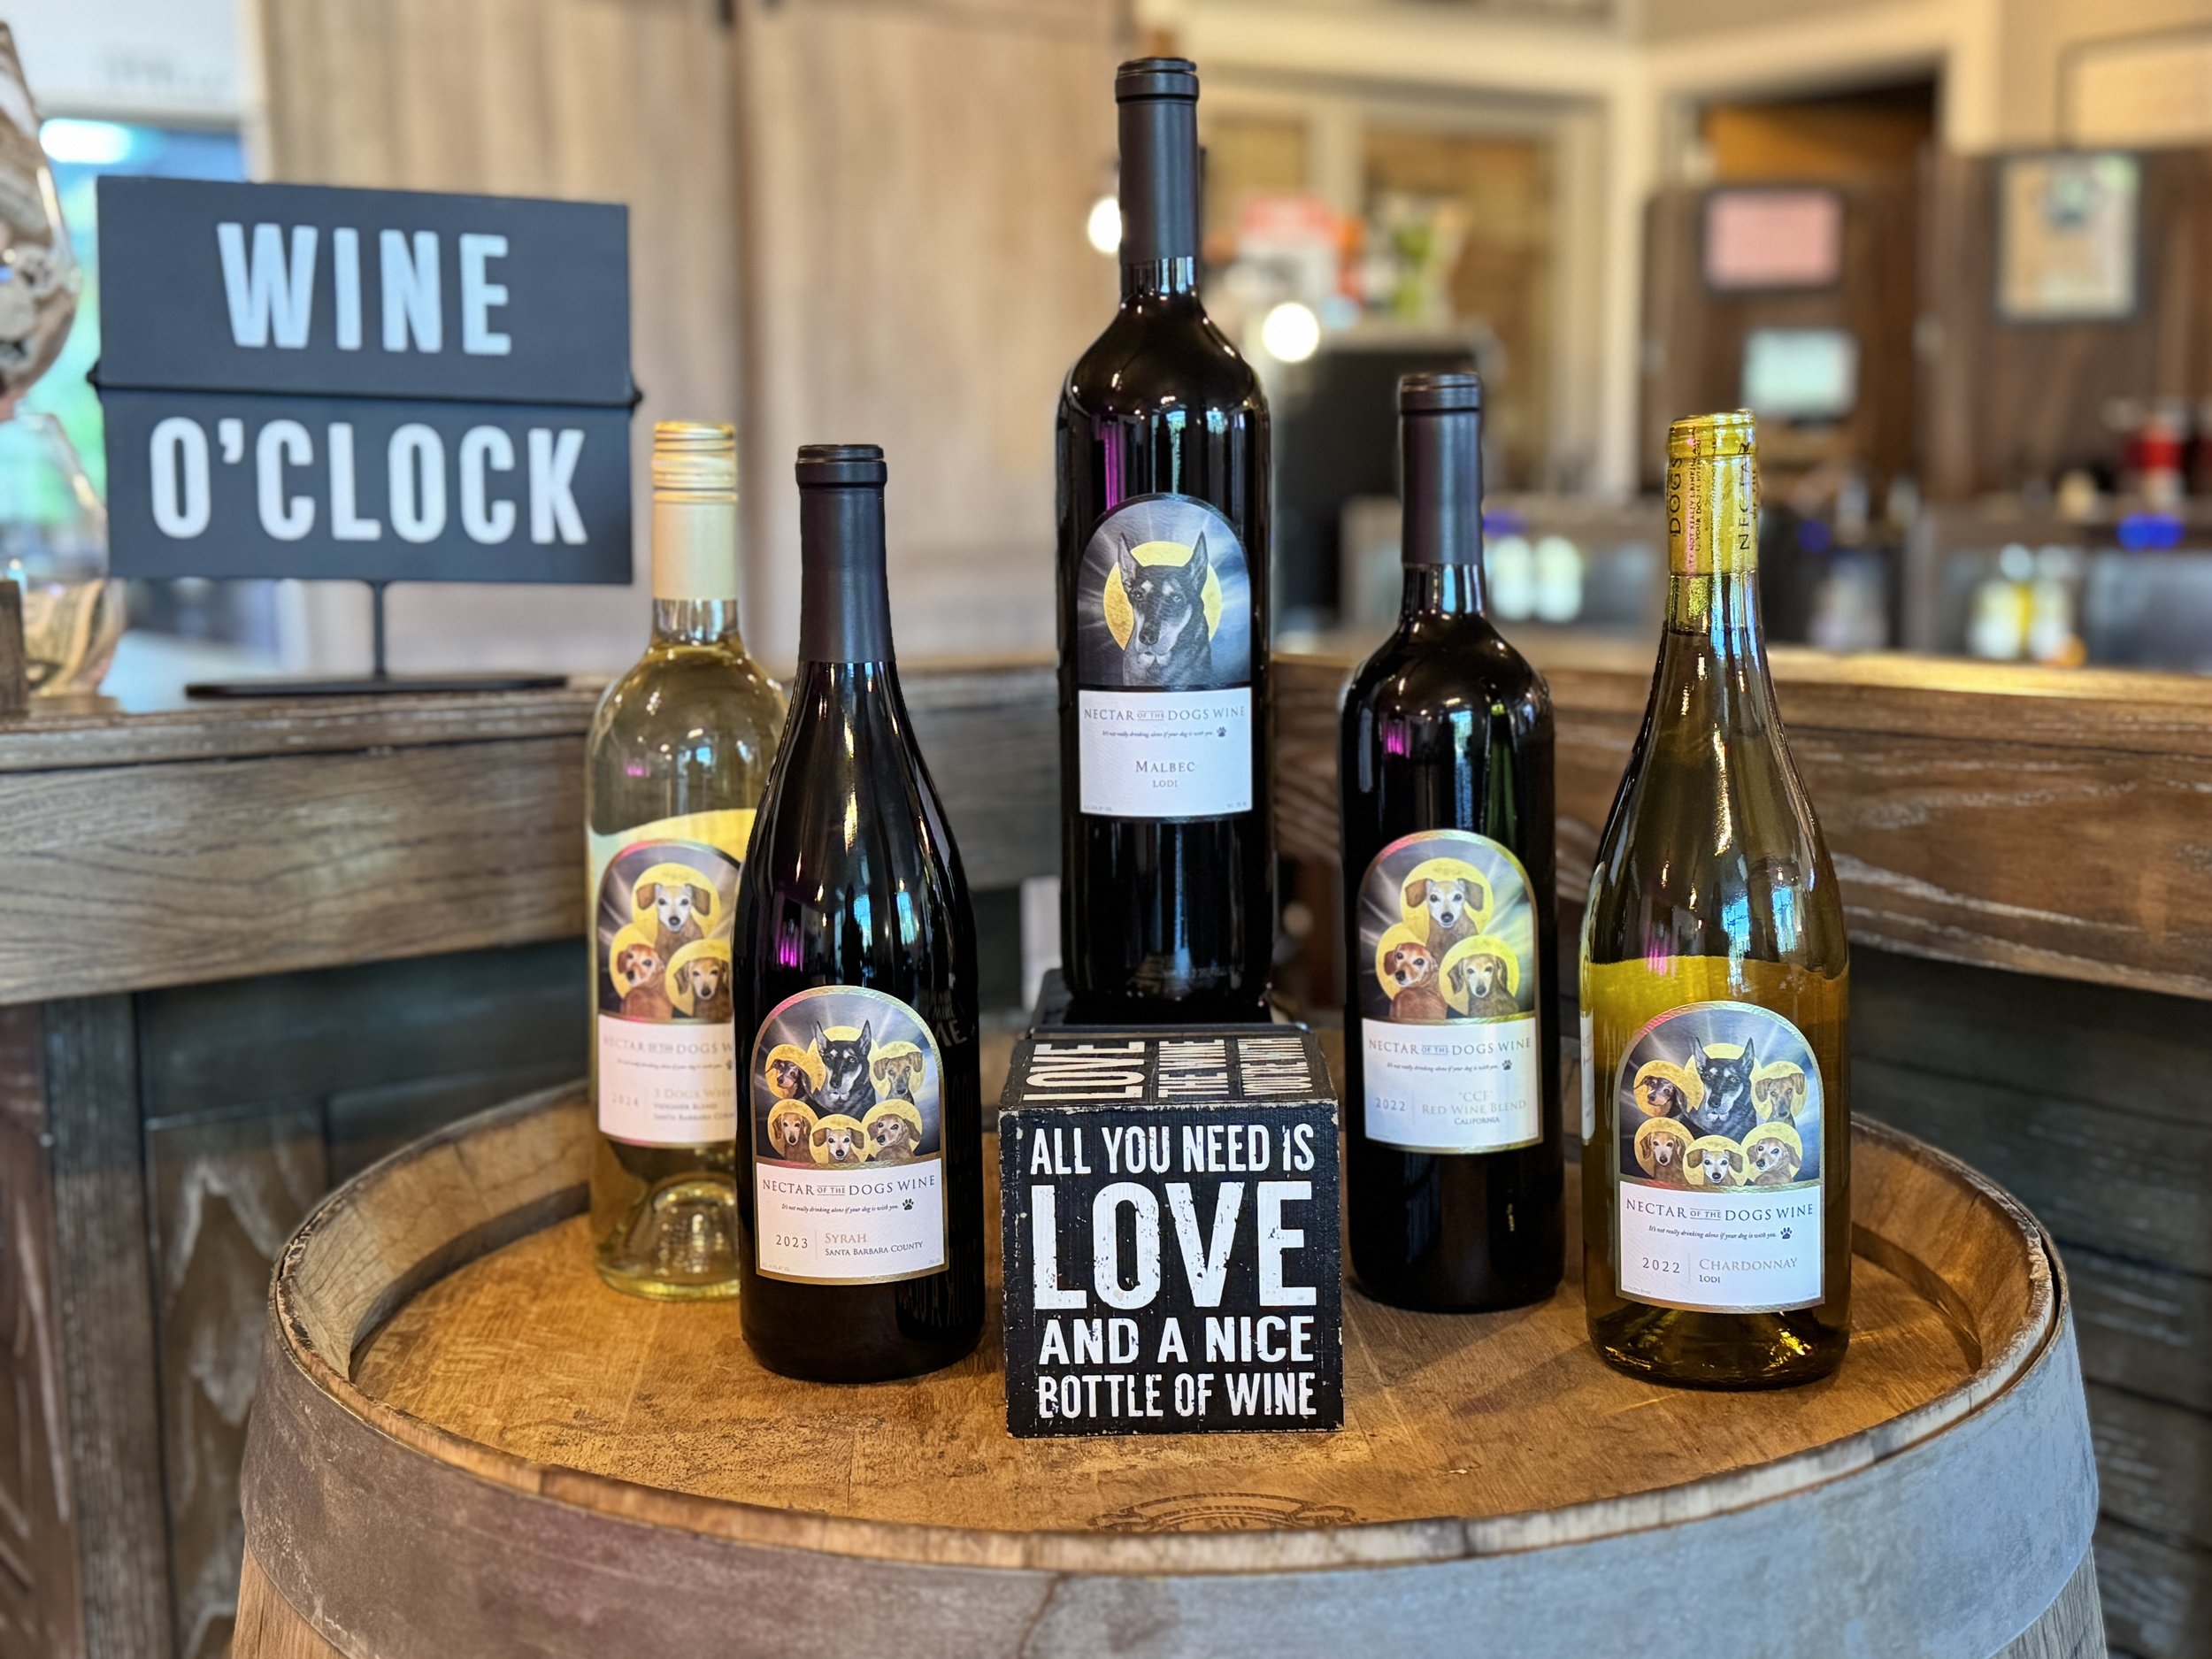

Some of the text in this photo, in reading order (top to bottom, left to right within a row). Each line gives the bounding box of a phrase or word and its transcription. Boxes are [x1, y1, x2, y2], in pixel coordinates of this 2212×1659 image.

[217, 222, 511, 357] WINE
[150, 416, 588, 546] O'CLOCK
[1670, 457, 1682, 537] DOGS
[1084, 708, 1135, 721] NECTAR
[1168, 709, 1209, 721] DOGS
[1213, 706, 1246, 718] WINE
[1135, 761, 1195, 773] MALBEC
[676, 1044, 718, 1054] DOGS
[1369, 1040, 1419, 1055] NECTAR
[1452, 1044, 1494, 1056] DOGS
[1498, 1038, 1531, 1050] WINE
[1023, 1041, 1145, 1101] LOVE
[1158, 1039, 1229, 1097] THE WINE
[1238, 1038, 1313, 1096] YOU'RE WITH
[1375, 1098, 1406, 1111] 2022
[1422, 1100, 1527, 1115] RED WINE BLEND
[1454, 1117, 1500, 1125] CALIFORNIA
[1030, 1124, 1315, 1174] ALL YOU NEED IS
[763, 1179, 815, 1195] NECTAR
[849, 1182, 893, 1195] DOGS
[897, 1175, 935, 1191] WINE
[1626, 1198, 1687, 1218] NECTAR
[1724, 1209, 1772, 1221] DOGS
[1776, 1203, 1813, 1218] WINE
[776, 1234, 808, 1248] 2023
[825, 1233, 866, 1243] SYRAH
[1031, 1180, 1317, 1310] LOVE
[826, 1248, 850, 1256] SANTA
[891, 1240, 923, 1253] COUNTY
[1642, 1256, 1680, 1274] 2022
[1699, 1257, 1798, 1271] CHARDONNAY
[1699, 1274, 1721, 1284] LODI
[1039, 1315, 1315, 1365] AND A NICE
[1038, 1371, 1317, 1418] BOTTLE OF WINE
